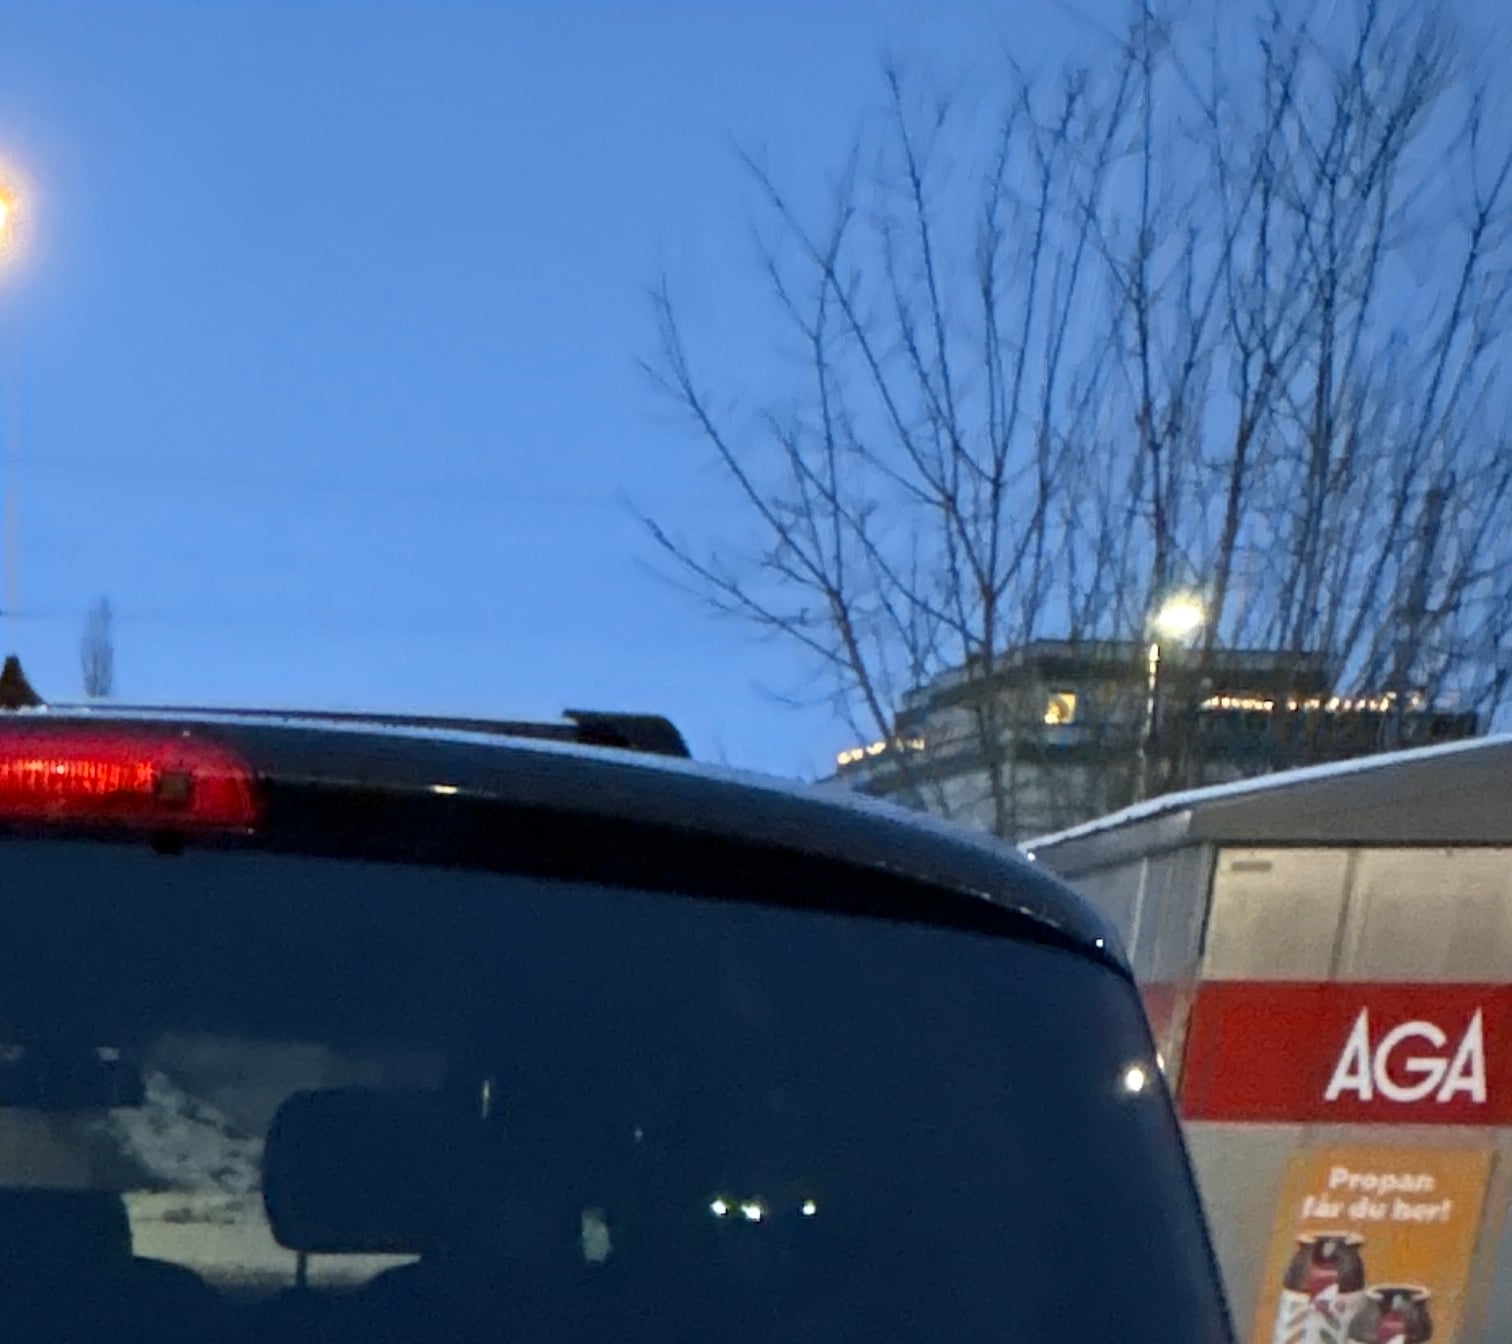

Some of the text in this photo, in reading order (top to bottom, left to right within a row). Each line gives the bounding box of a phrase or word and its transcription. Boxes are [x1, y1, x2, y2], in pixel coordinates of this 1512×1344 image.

[1324, 1005, 1487, 1103] AGA
[1328, 1167, 1435, 1196] Propan
[1347, 1196, 1387, 1222] du
